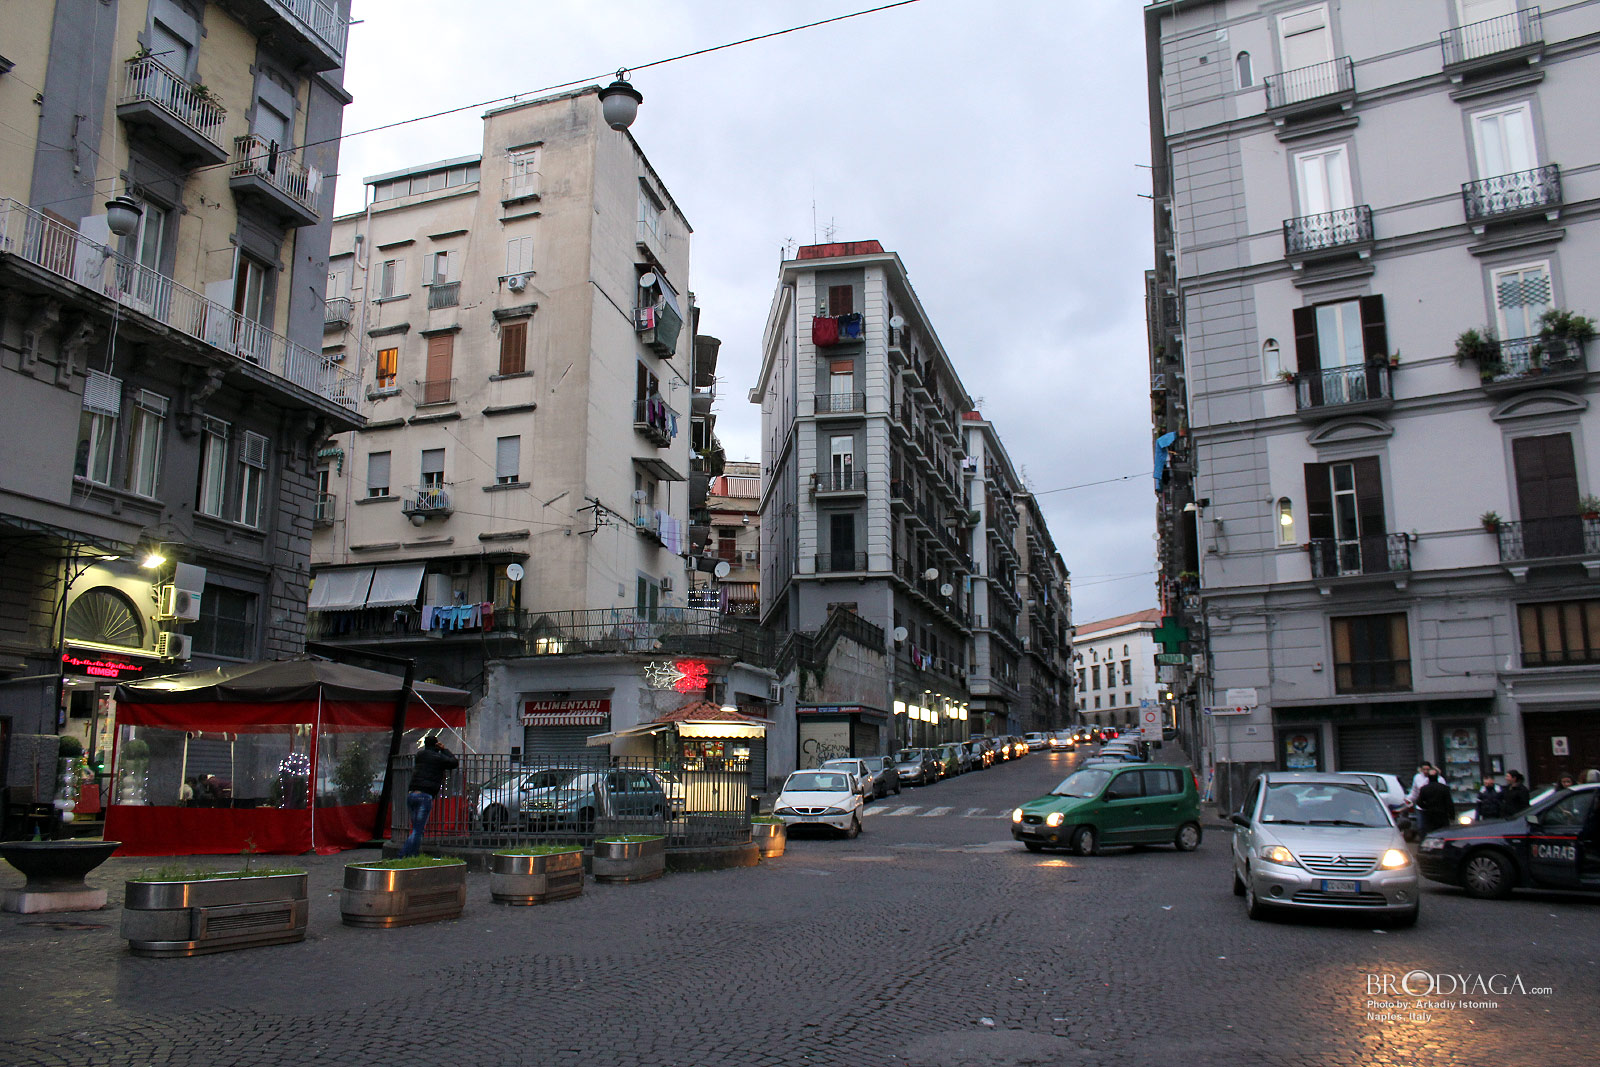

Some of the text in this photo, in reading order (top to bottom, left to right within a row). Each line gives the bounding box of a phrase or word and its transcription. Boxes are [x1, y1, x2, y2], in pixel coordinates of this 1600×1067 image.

[87, 666, 120, 678] KIMBO
[533, 700, 601, 711] ALIMENTARI
[1538, 844, 1577, 860] CARAB
